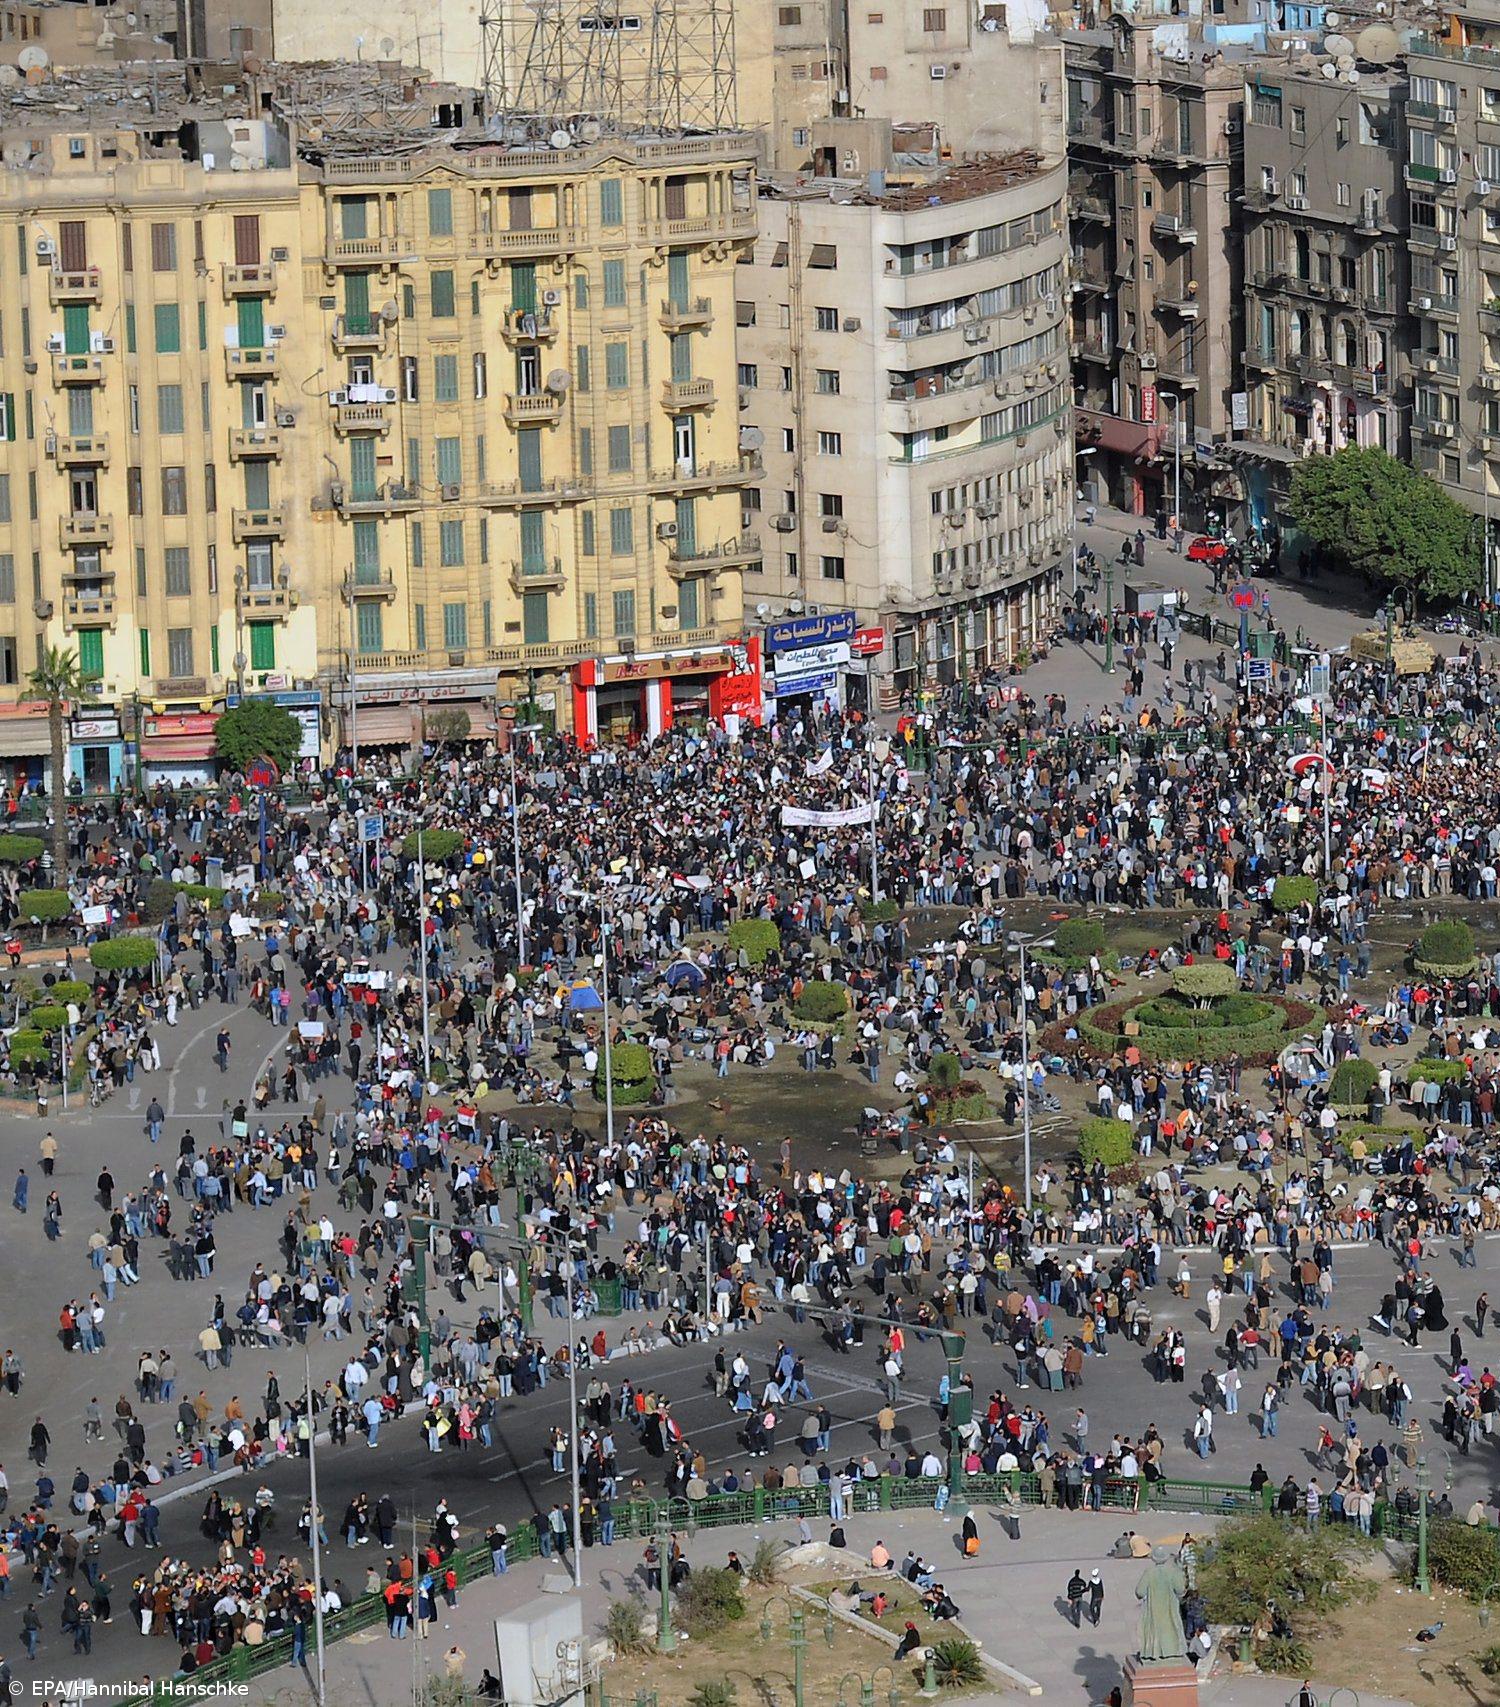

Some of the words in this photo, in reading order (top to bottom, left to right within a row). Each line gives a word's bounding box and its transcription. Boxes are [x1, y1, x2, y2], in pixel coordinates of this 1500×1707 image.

[773, 618, 826, 643] للسياحة
[825, 614, 854, 639] وندر
[362, 690, 395, 703] النيل
